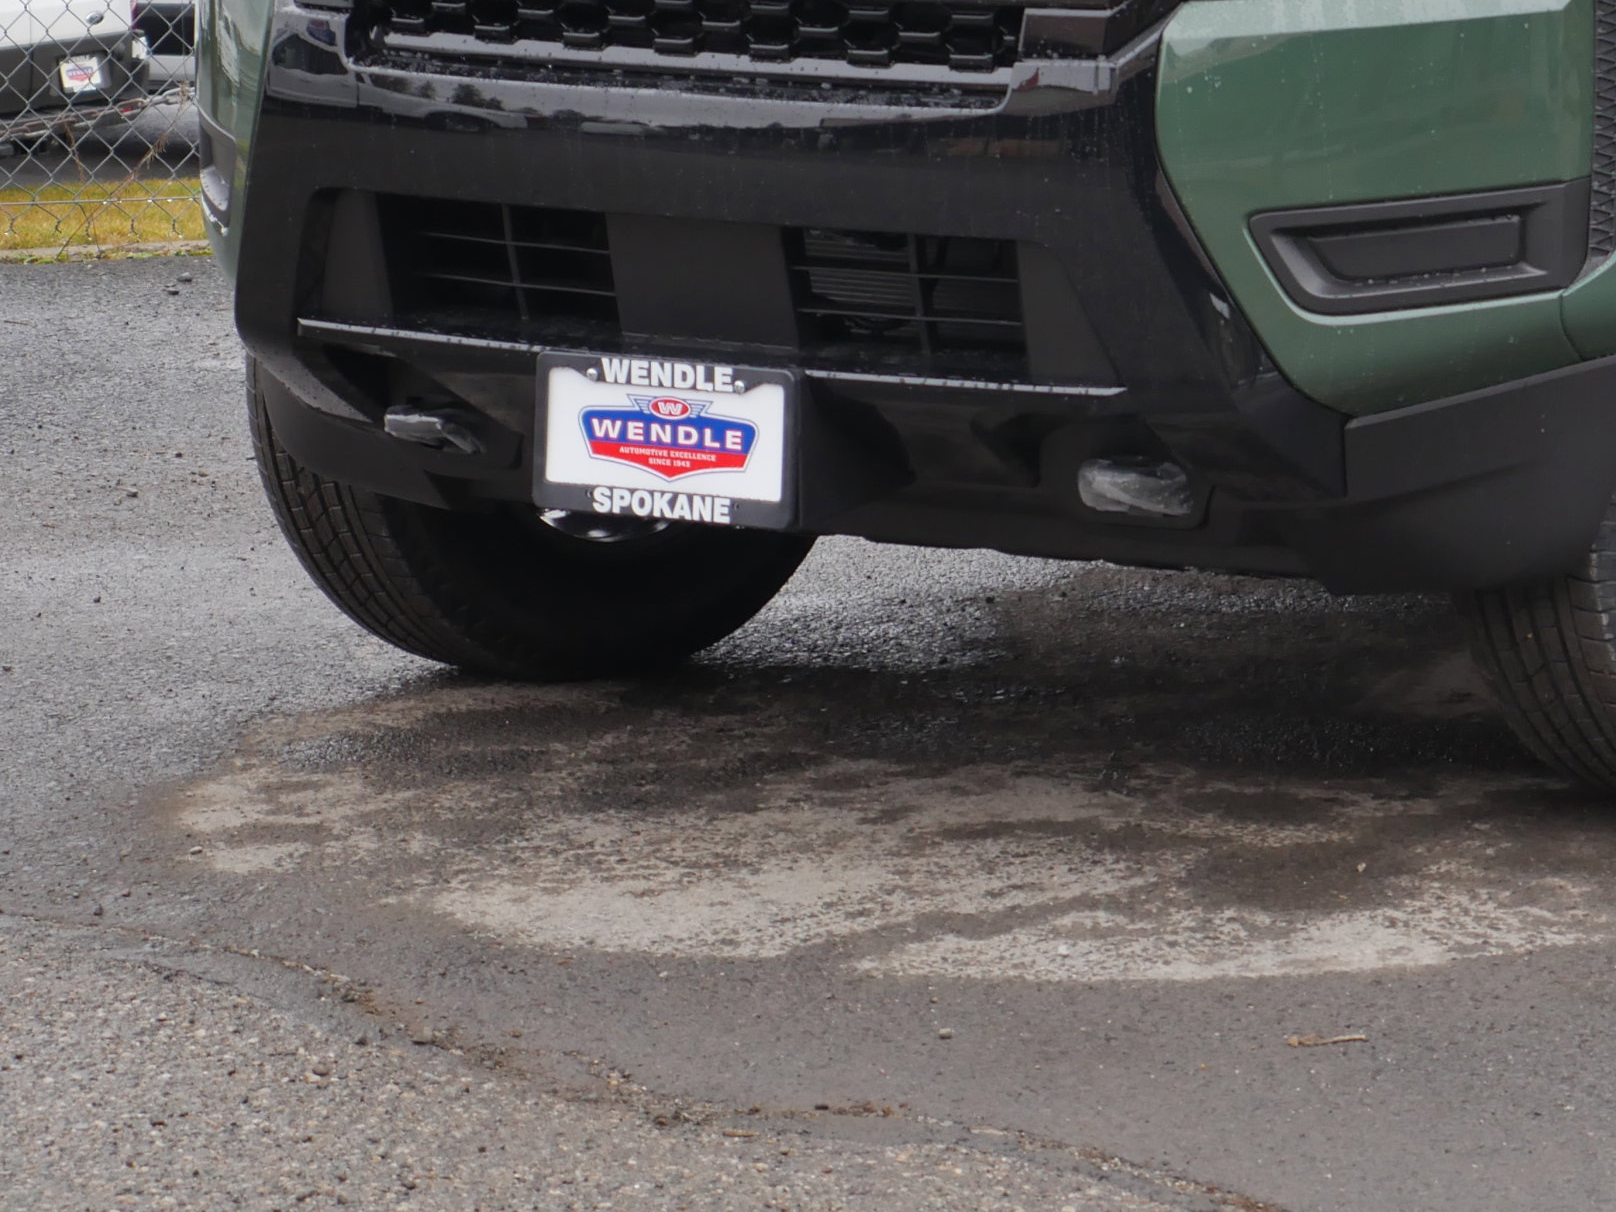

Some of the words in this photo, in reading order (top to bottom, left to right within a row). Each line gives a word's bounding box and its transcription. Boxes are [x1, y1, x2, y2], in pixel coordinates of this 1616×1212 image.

[600, 357, 735, 393] WENDLE
[591, 418, 743, 450] WENDLE
[618, 446, 669, 458] AUTOMOTIVE
[669, 450, 717, 463] EXCELLENCE
[648, 457, 672, 468] SINCE
[591, 486, 732, 525] SPOKANE
